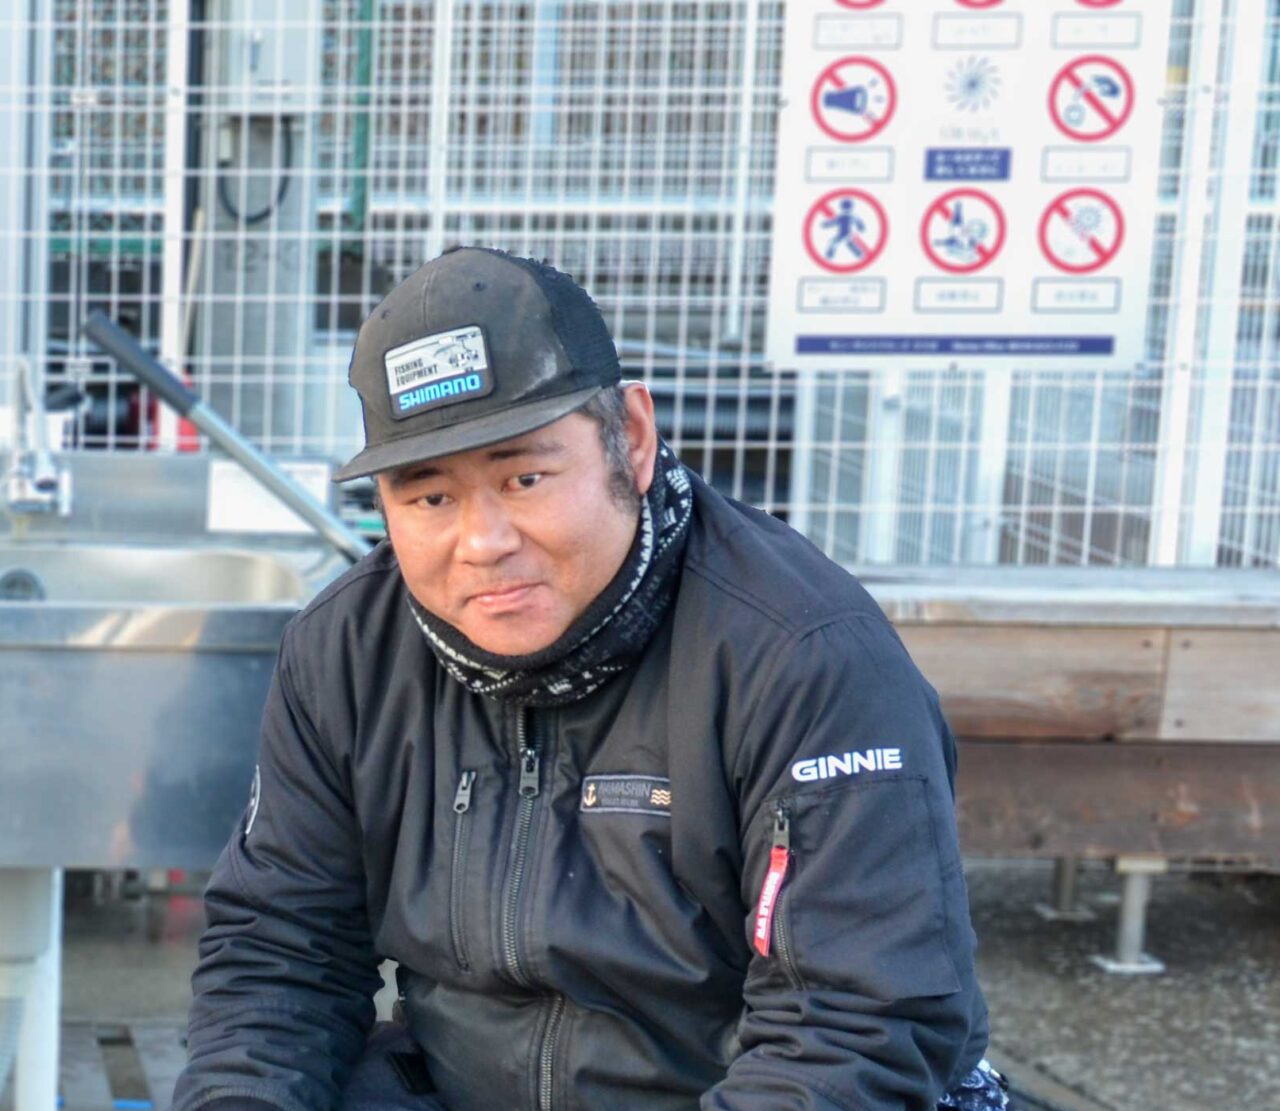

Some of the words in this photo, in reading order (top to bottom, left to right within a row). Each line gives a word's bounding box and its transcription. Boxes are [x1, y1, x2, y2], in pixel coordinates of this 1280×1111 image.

[394, 358, 424, 375] FISHING
[396, 364, 438, 387] EQUIPMENT
[399, 374, 481, 410] SHIMANO
[791, 747, 903, 782] GINNIE
